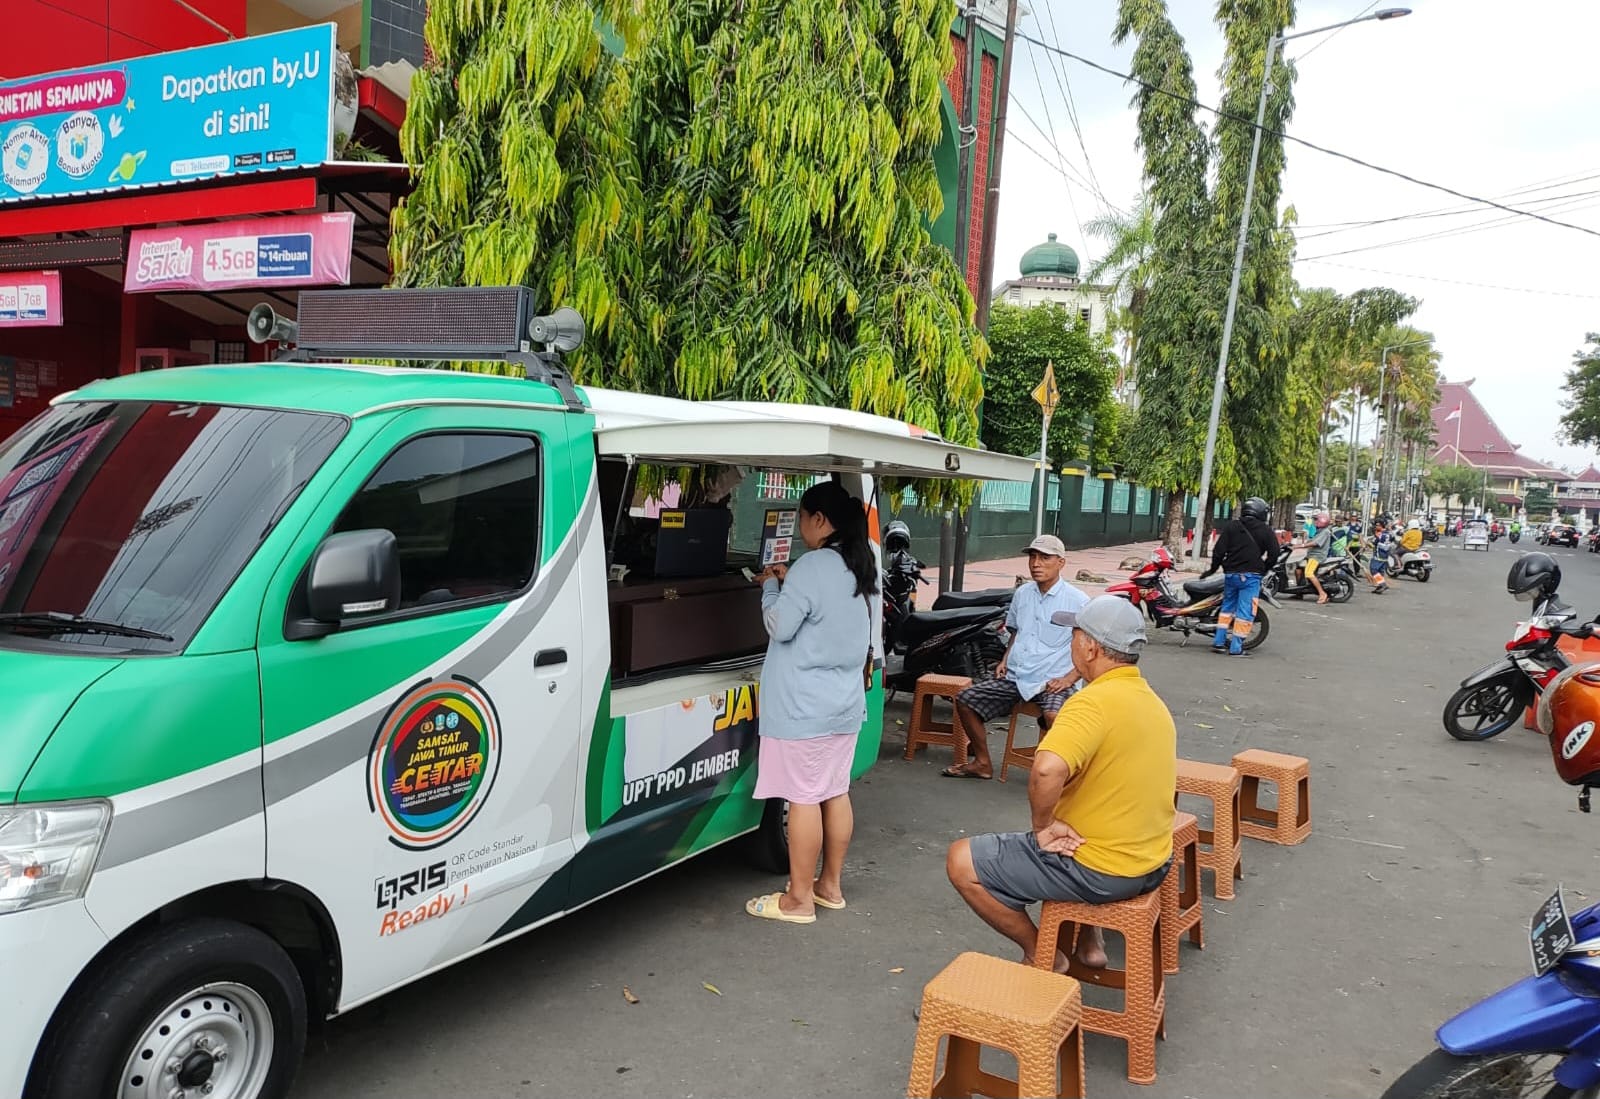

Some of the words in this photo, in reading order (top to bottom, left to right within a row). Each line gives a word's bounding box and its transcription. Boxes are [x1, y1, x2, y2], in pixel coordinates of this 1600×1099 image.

[162, 64, 266, 104] Dapatkan
[272, 50, 320, 89] by.U
[46, 78, 113, 107] SEMAUNYA
[62, 116, 98, 134] Banyak
[203, 109, 224, 138] di
[229, 103, 270, 135] sini!
[3, 131, 28, 153] Nomor
[29, 129, 48, 147] Aktif
[58, 157, 80, 174] Bonus
[81, 152, 103, 173] Kuota
[5, 172, 46, 187] Selamanya
[142, 239, 181, 256] Internet
[206, 249, 255, 272] 4.5GB
[138, 247, 192, 281] Sakti
[24, 293, 42, 307] 7GB
[714, 682, 760, 732] JA
[408, 751, 435, 767] JAWA
[438, 742, 469, 758] TIMUR
[416, 731, 461, 750] SAMSAT
[1565, 726, 1588, 755] INK
[622, 776, 655, 806] UPT
[656, 766, 687, 795] PPD
[688, 748, 740, 784] JEMBER
[450, 856, 502, 882] Pembayaran
[504, 841, 538, 862] Nasional
[451, 854, 466, 867] QR
[468, 846, 490, 861] Code
[493, 834, 524, 852] Standar
[376, 860, 447, 910] QRIS
[380, 893, 456, 937] Ready
